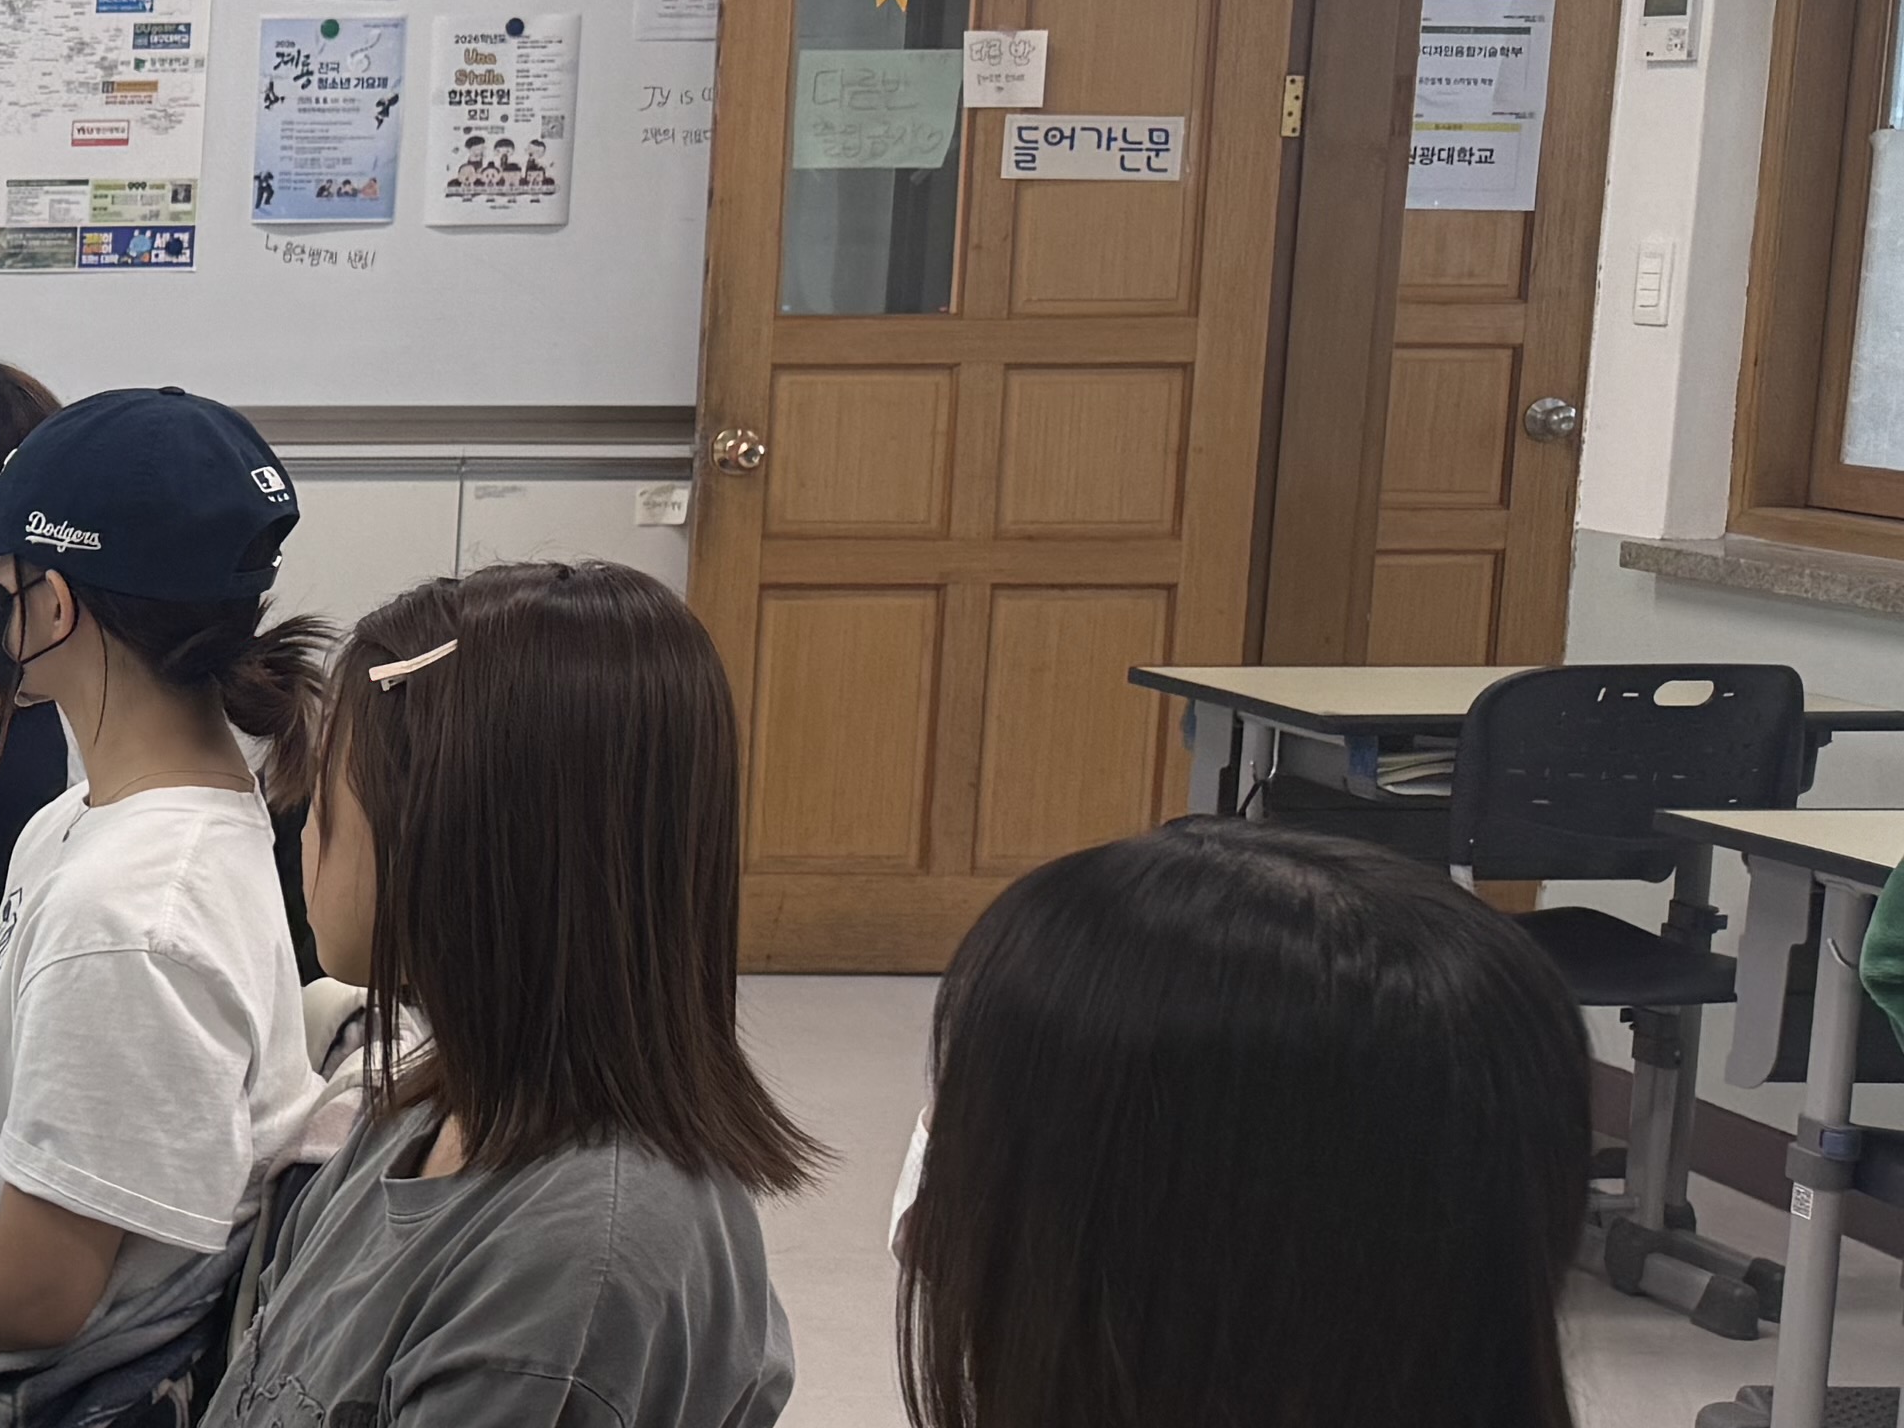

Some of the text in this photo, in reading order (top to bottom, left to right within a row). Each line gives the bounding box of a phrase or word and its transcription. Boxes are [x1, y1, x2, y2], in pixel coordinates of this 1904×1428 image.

[448, 89, 511, 106] 합창단원
[467, 108, 489, 121] 모집
[1013, 125, 1171, 173] 들어가는문
[25, 511, 101, 552] Dodgers
